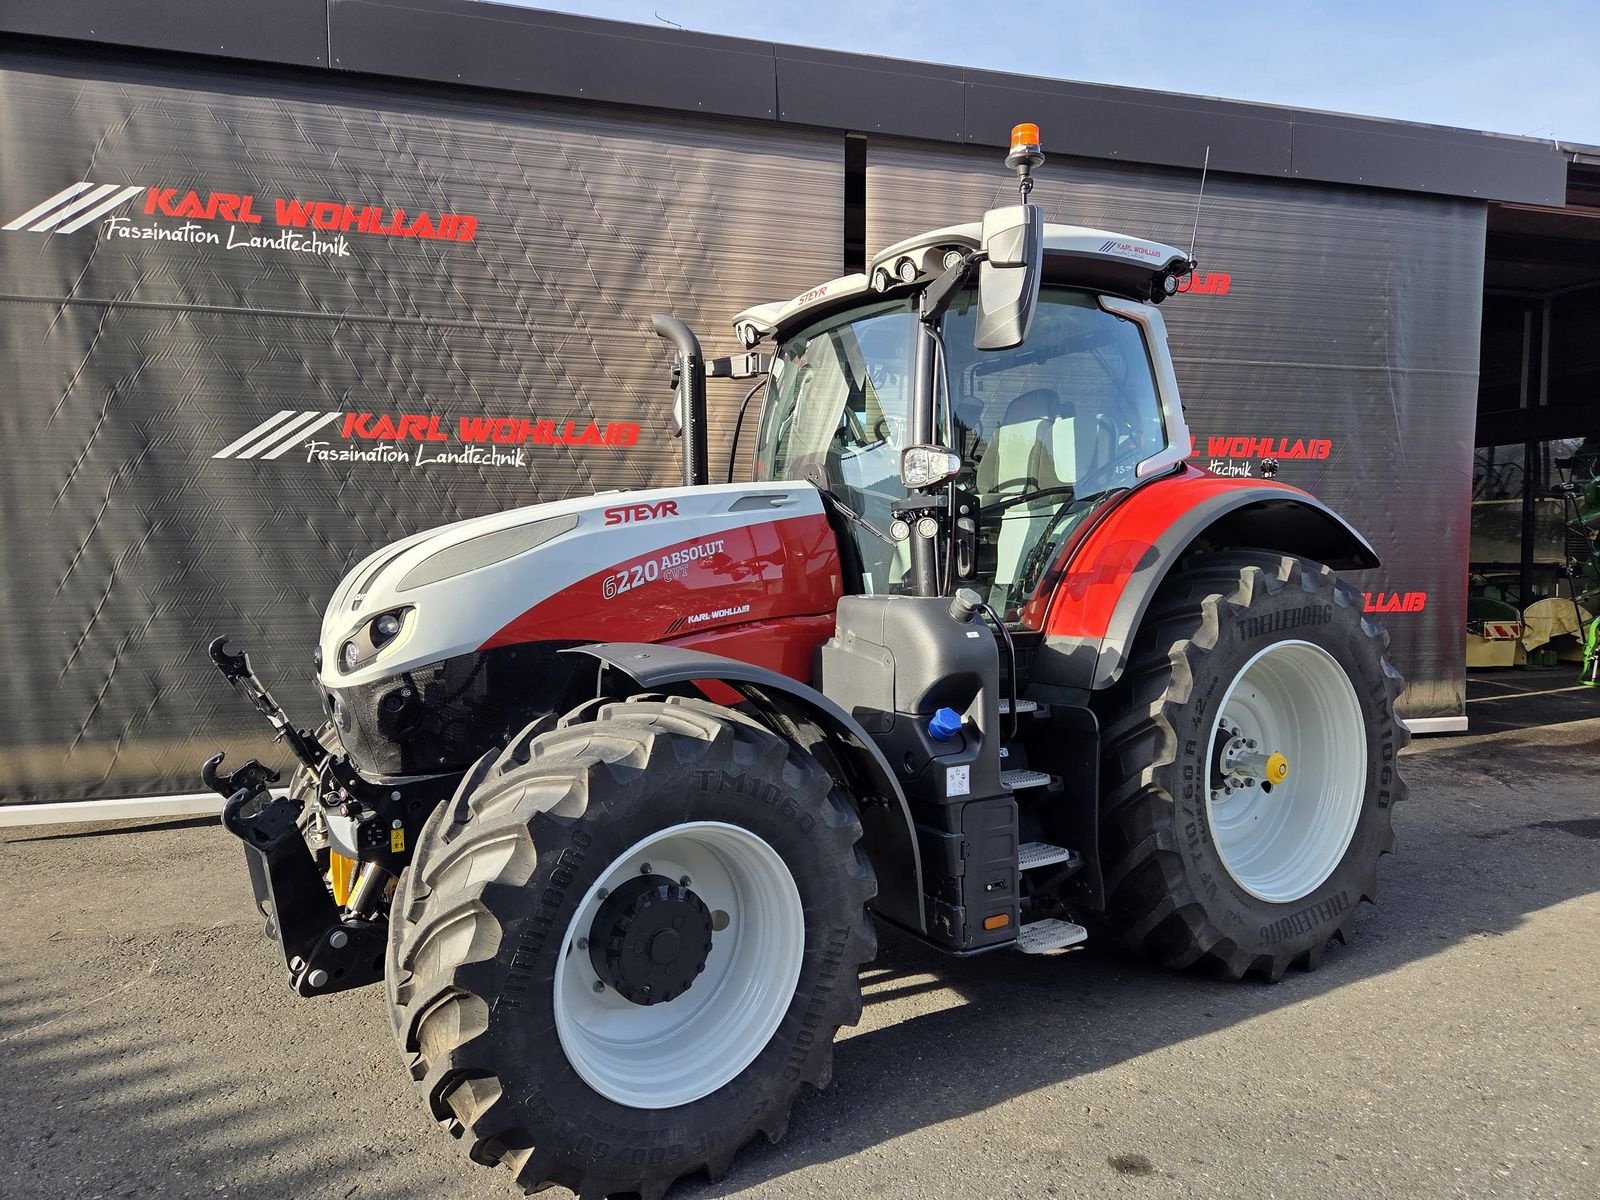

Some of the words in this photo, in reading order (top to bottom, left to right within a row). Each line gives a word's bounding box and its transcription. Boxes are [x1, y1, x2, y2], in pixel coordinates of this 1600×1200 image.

[143, 186, 262, 224] KARL
[275, 198, 478, 242] WOHLLAIB
[105, 216, 220, 244] Faszination
[226, 225, 350, 257] Landtechnik
[799, 287, 827, 305] STEYR
[341, 412, 448, 440] KARL
[459, 416, 641, 447] WOHLLAIB
[304, 440, 410, 464] Faszination
[415, 443, 526, 468] Landtechnik
[1208, 436, 1332, 460] WOHLLAIB
[604, 500, 680, 526] STEYR
[602, 560, 659, 600] 6220
[660, 540, 725, 571] ABSOLUT
[663, 564, 689, 583] CVT
[688, 613, 710, 624] KARL
[1363, 592, 1428, 613] LLAIB
[1236, 604, 1333, 640] TRELLEBORG
[694, 769, 817, 835] TM1060
[492, 829, 592, 1013] TRELLEBORG
[1259, 890, 1350, 946] TRELLEBORG
[784, 926, 850, 1082] TRELLEBORG
